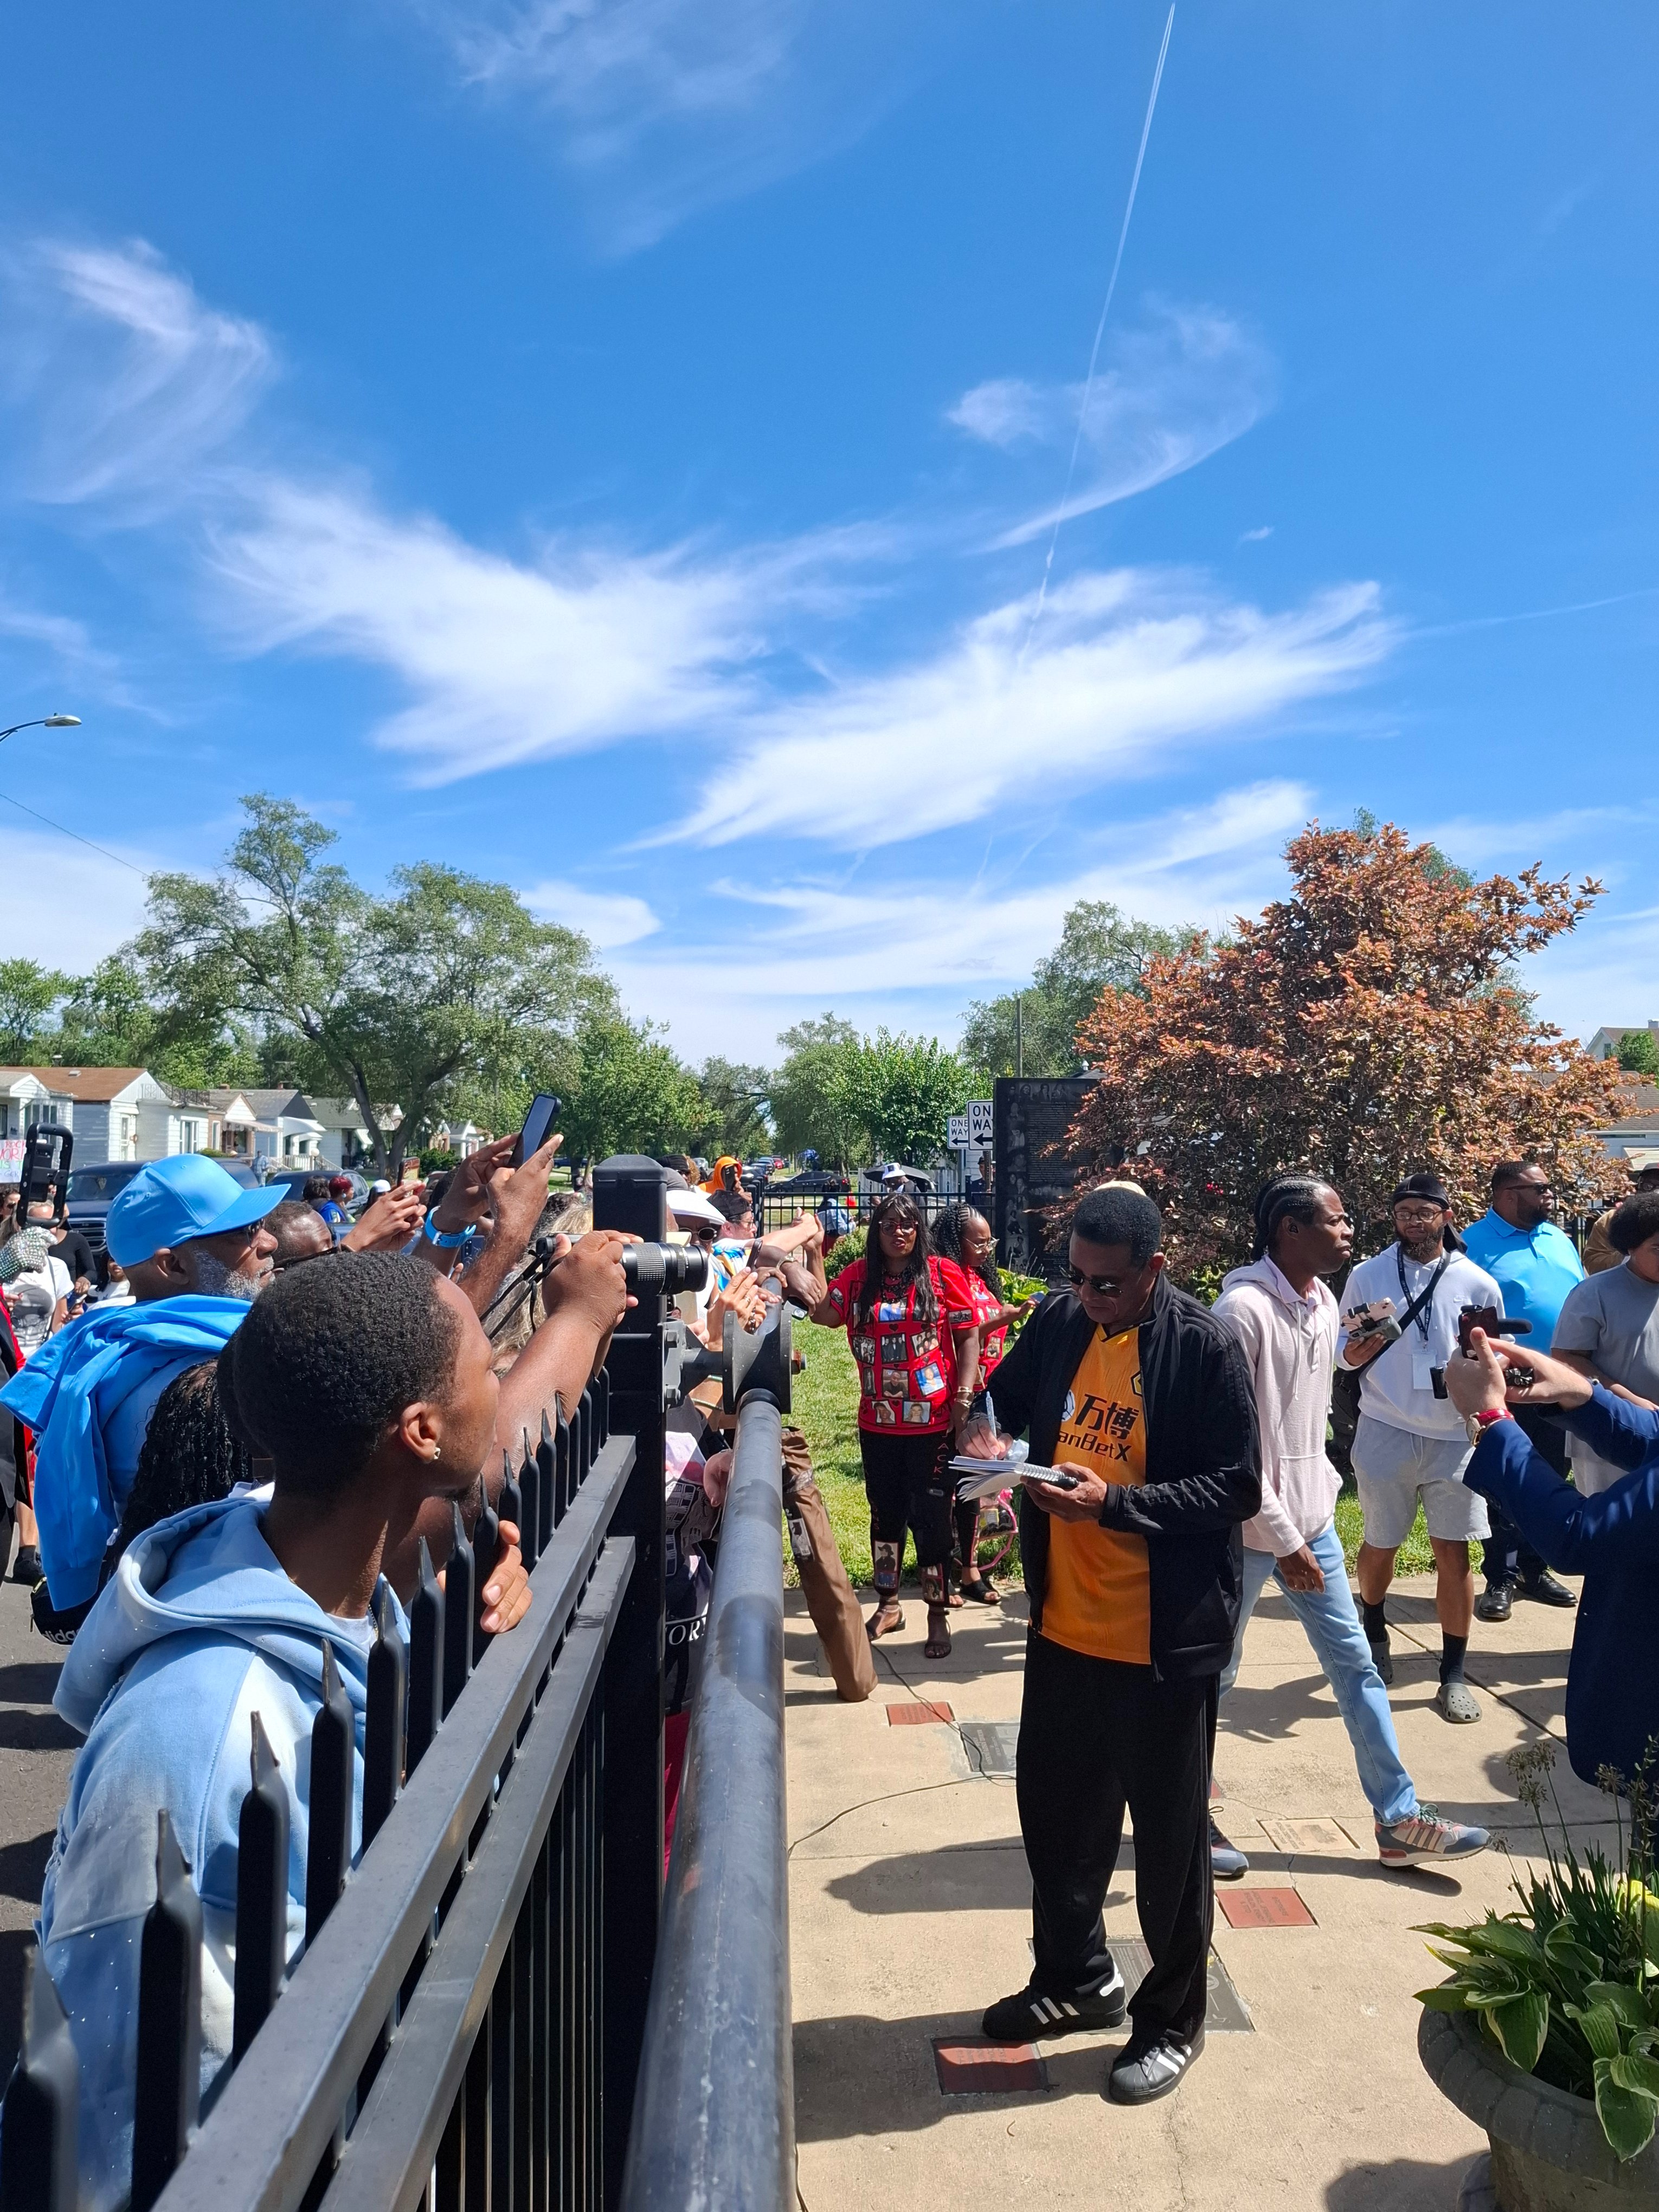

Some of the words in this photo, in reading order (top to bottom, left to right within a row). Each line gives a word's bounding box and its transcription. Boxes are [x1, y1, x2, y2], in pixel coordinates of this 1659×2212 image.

[951, 1119, 968, 1127] ONE
[973, 1105, 991, 1117] ON
[973, 1119, 993, 1131] WA
[1074, 1393, 1140, 1440] 万博
[933, 1431, 949, 1480] JACK
[1058, 1430, 1132, 1462] anBetX
[665, 1617, 706, 1645] OR
